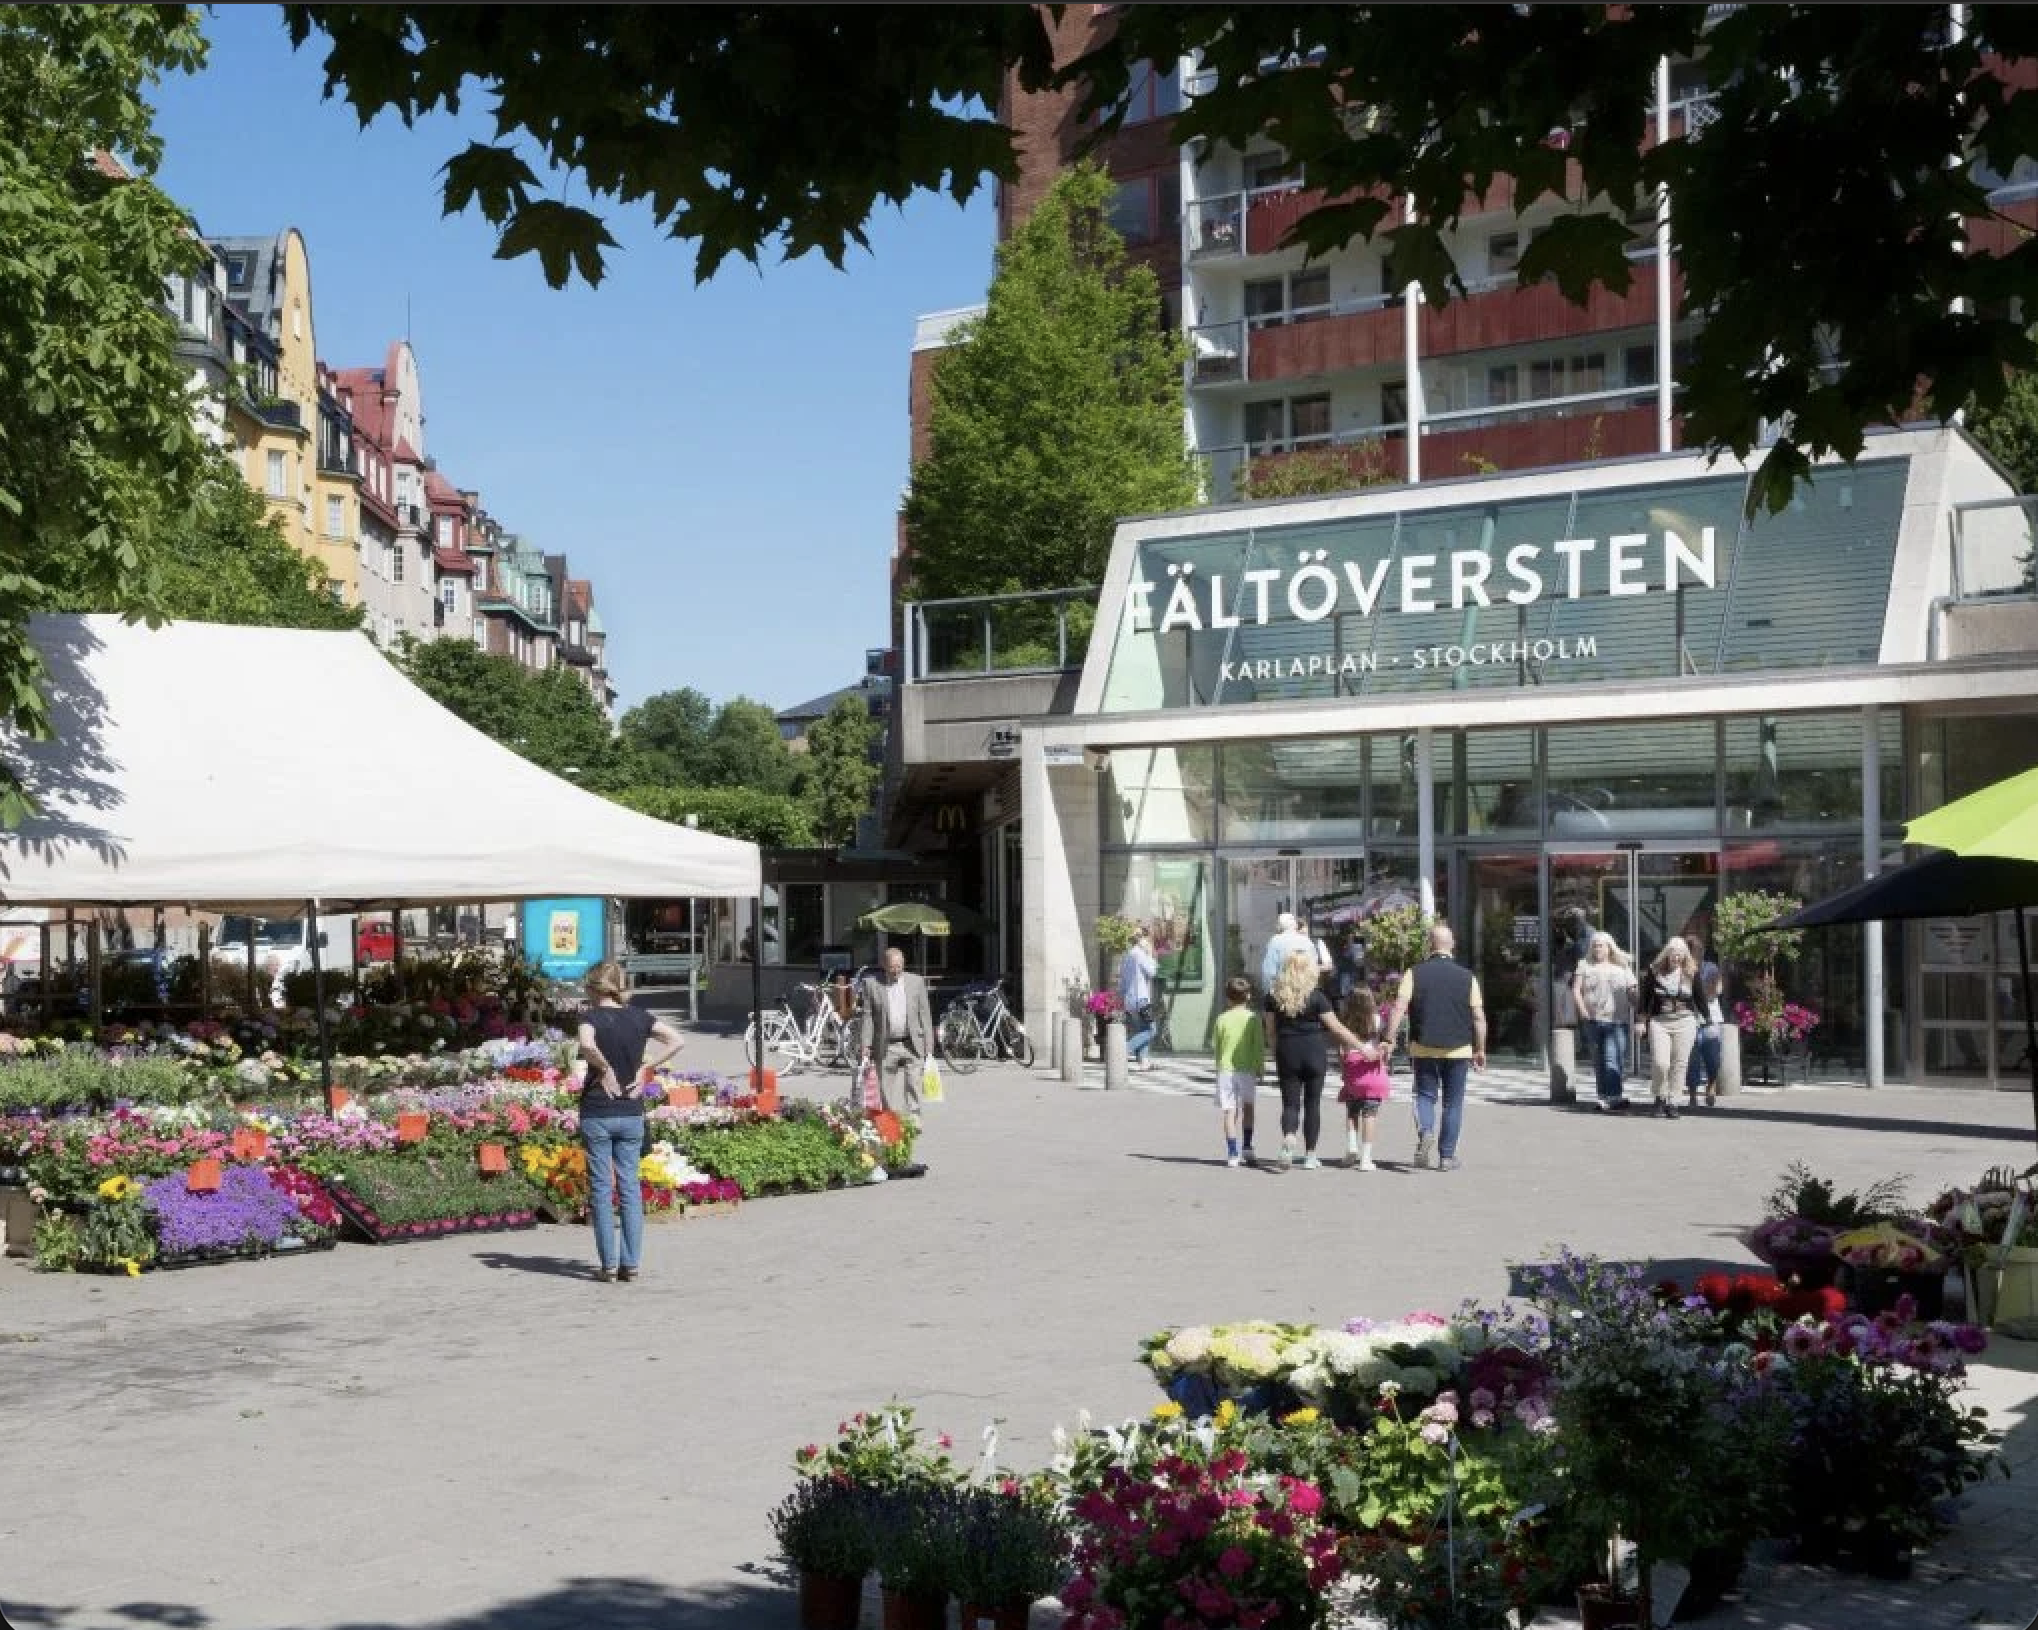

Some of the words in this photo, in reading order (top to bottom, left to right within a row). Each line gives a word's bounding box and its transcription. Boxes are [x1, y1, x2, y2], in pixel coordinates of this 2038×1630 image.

[1126, 527, 1717, 634] FÄLTÖVERSTEN
[1221, 652, 1378, 682] KARLAPLAN
[1412, 636, 1598, 670] STOCKHOLM
